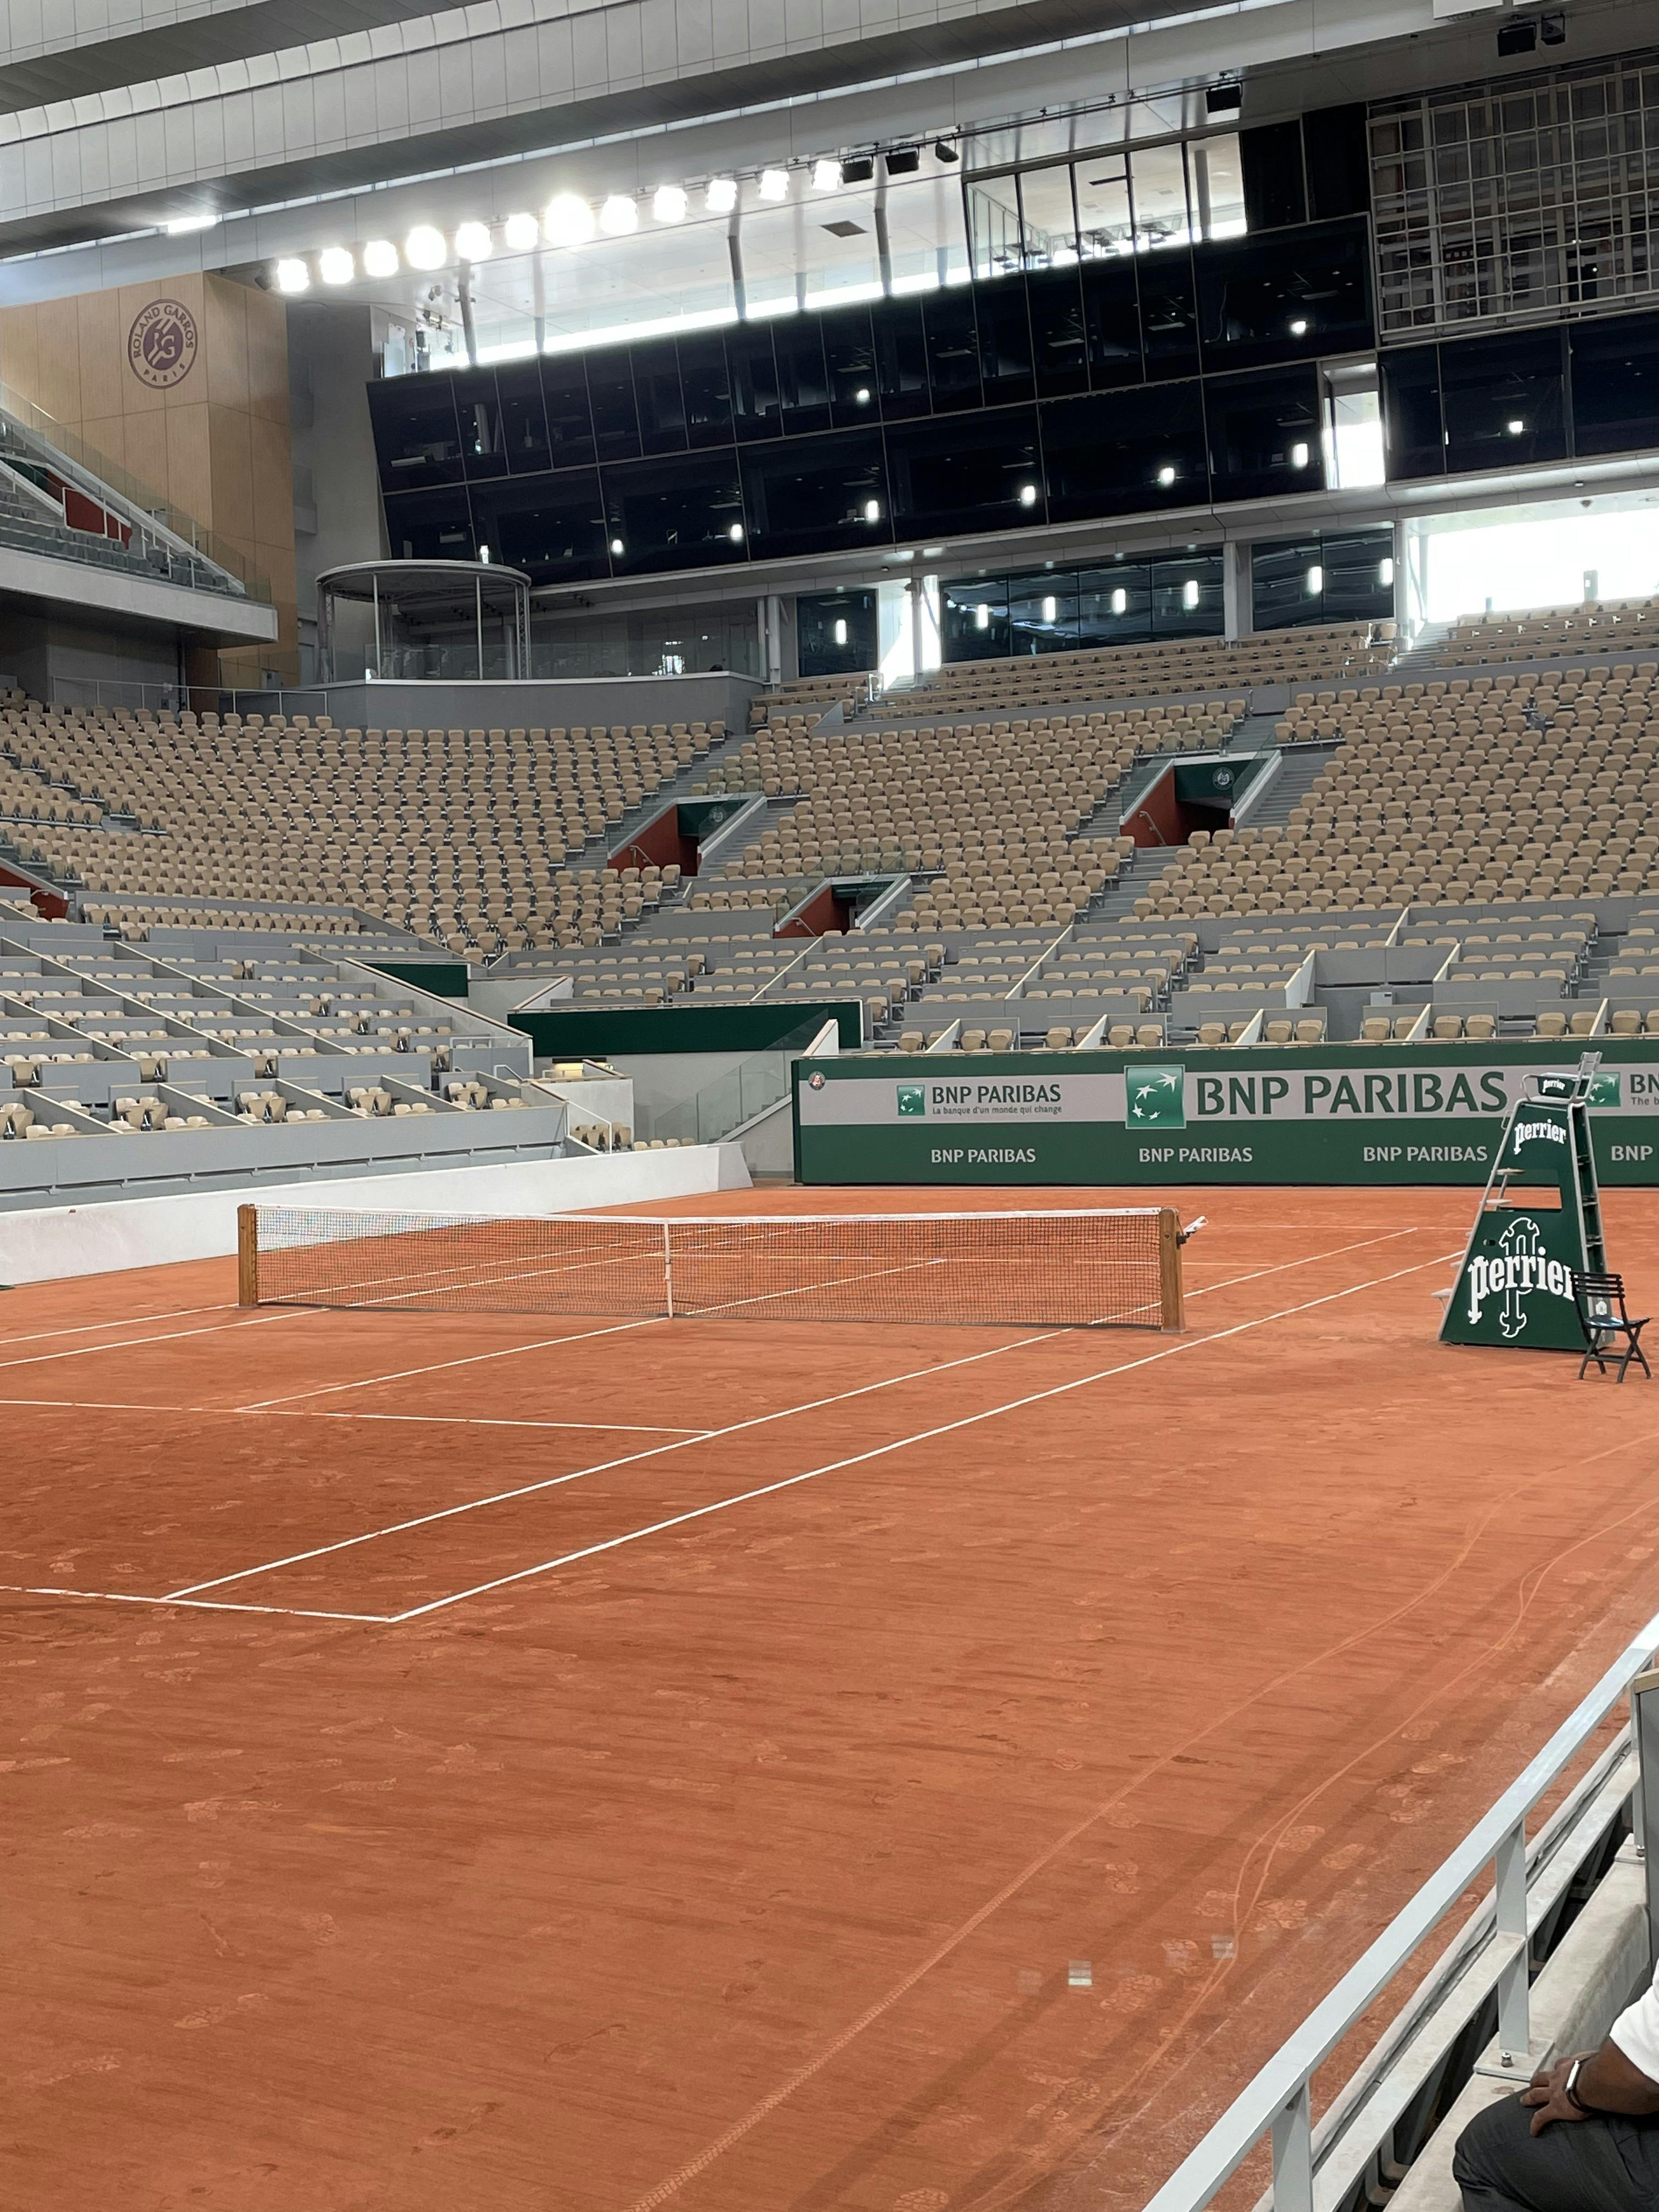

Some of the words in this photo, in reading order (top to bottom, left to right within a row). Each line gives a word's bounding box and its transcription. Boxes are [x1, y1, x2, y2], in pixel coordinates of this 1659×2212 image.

[133, 307, 160, 358] ROLAND
[164, 304, 194, 348] GARROS
[143, 363, 185, 382] PARIS
[932, 1086, 972, 1104] BNP
[977, 1084, 1062, 1103] PARIBAS
[1197, 1077, 1289, 1115] BNP
[1304, 1071, 1508, 1114] PARIBAS
[1631, 1097, 1649, 1105] The
[943, 1107, 970, 1115] banque
[991, 1105, 1018, 1114] monde
[1020, 1105, 1032, 1115] qui
[1034, 1105, 1062, 1115] change
[932, 1149, 964, 1163] BNP
[968, 1148, 1036, 1163] PARIBAS
[1139, 1148, 1175, 1163] BNP
[1179, 1147, 1253, 1163] PARIBAS
[1363, 1147, 1402, 1161] BNP
[1407, 1146, 1488, 1161] PARIBAS
[1611, 1145, 1654, 1161] BNP
